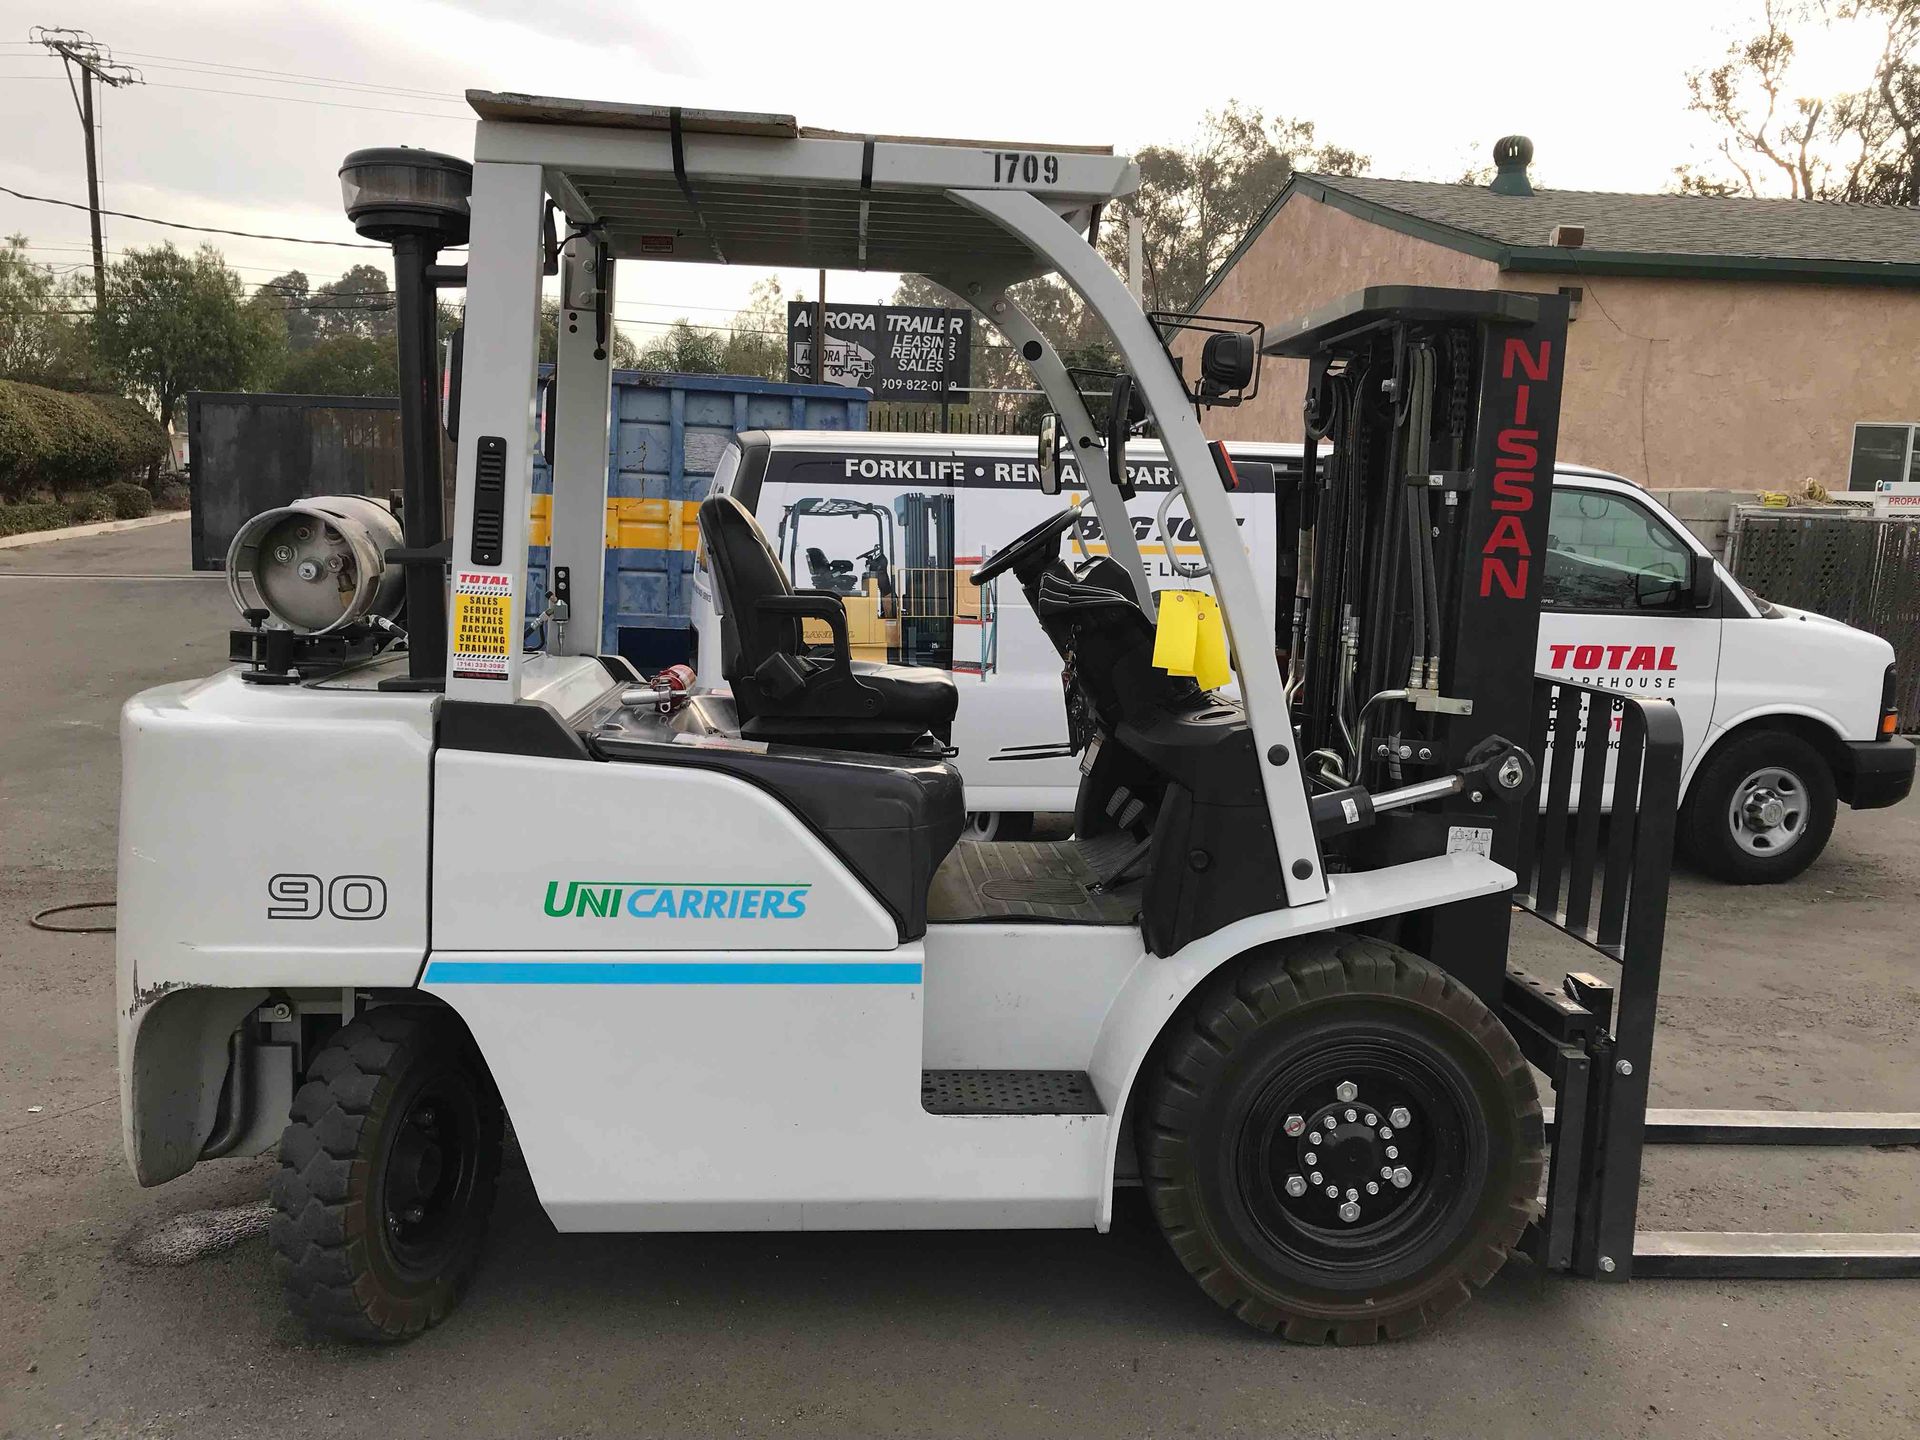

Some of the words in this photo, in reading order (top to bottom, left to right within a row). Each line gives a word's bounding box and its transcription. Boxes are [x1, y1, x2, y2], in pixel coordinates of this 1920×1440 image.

[994, 154, 1058, 184] 1709
[794, 311, 876, 331] ARORA
[886, 315, 964, 334] TRAILER
[893, 334, 957, 349] LEASING
[801, 349, 840, 362] AORA
[890, 347, 956, 361] RENTALS
[898, 359, 944, 373] SALES
[882, 378, 957, 391] 909-822-019
[994, 464, 1087, 484] RENA
[1479, 338, 1551, 600] NISSAN
[1067, 516, 1155, 541] BG
[1155, 517, 1246, 542] JO
[460, 574, 509, 585] TOTAL
[469, 596, 498, 605] SALES
[463, 605, 504, 616] SERVICE
[462, 615, 503, 625] RENTALS
[461, 624, 504, 635] RACKING
[459, 634, 505, 644] SHELVING
[458, 643, 505, 654] TRAINING
[1549, 645, 1678, 671] TOTAL
[268, 873, 388, 921] 90
